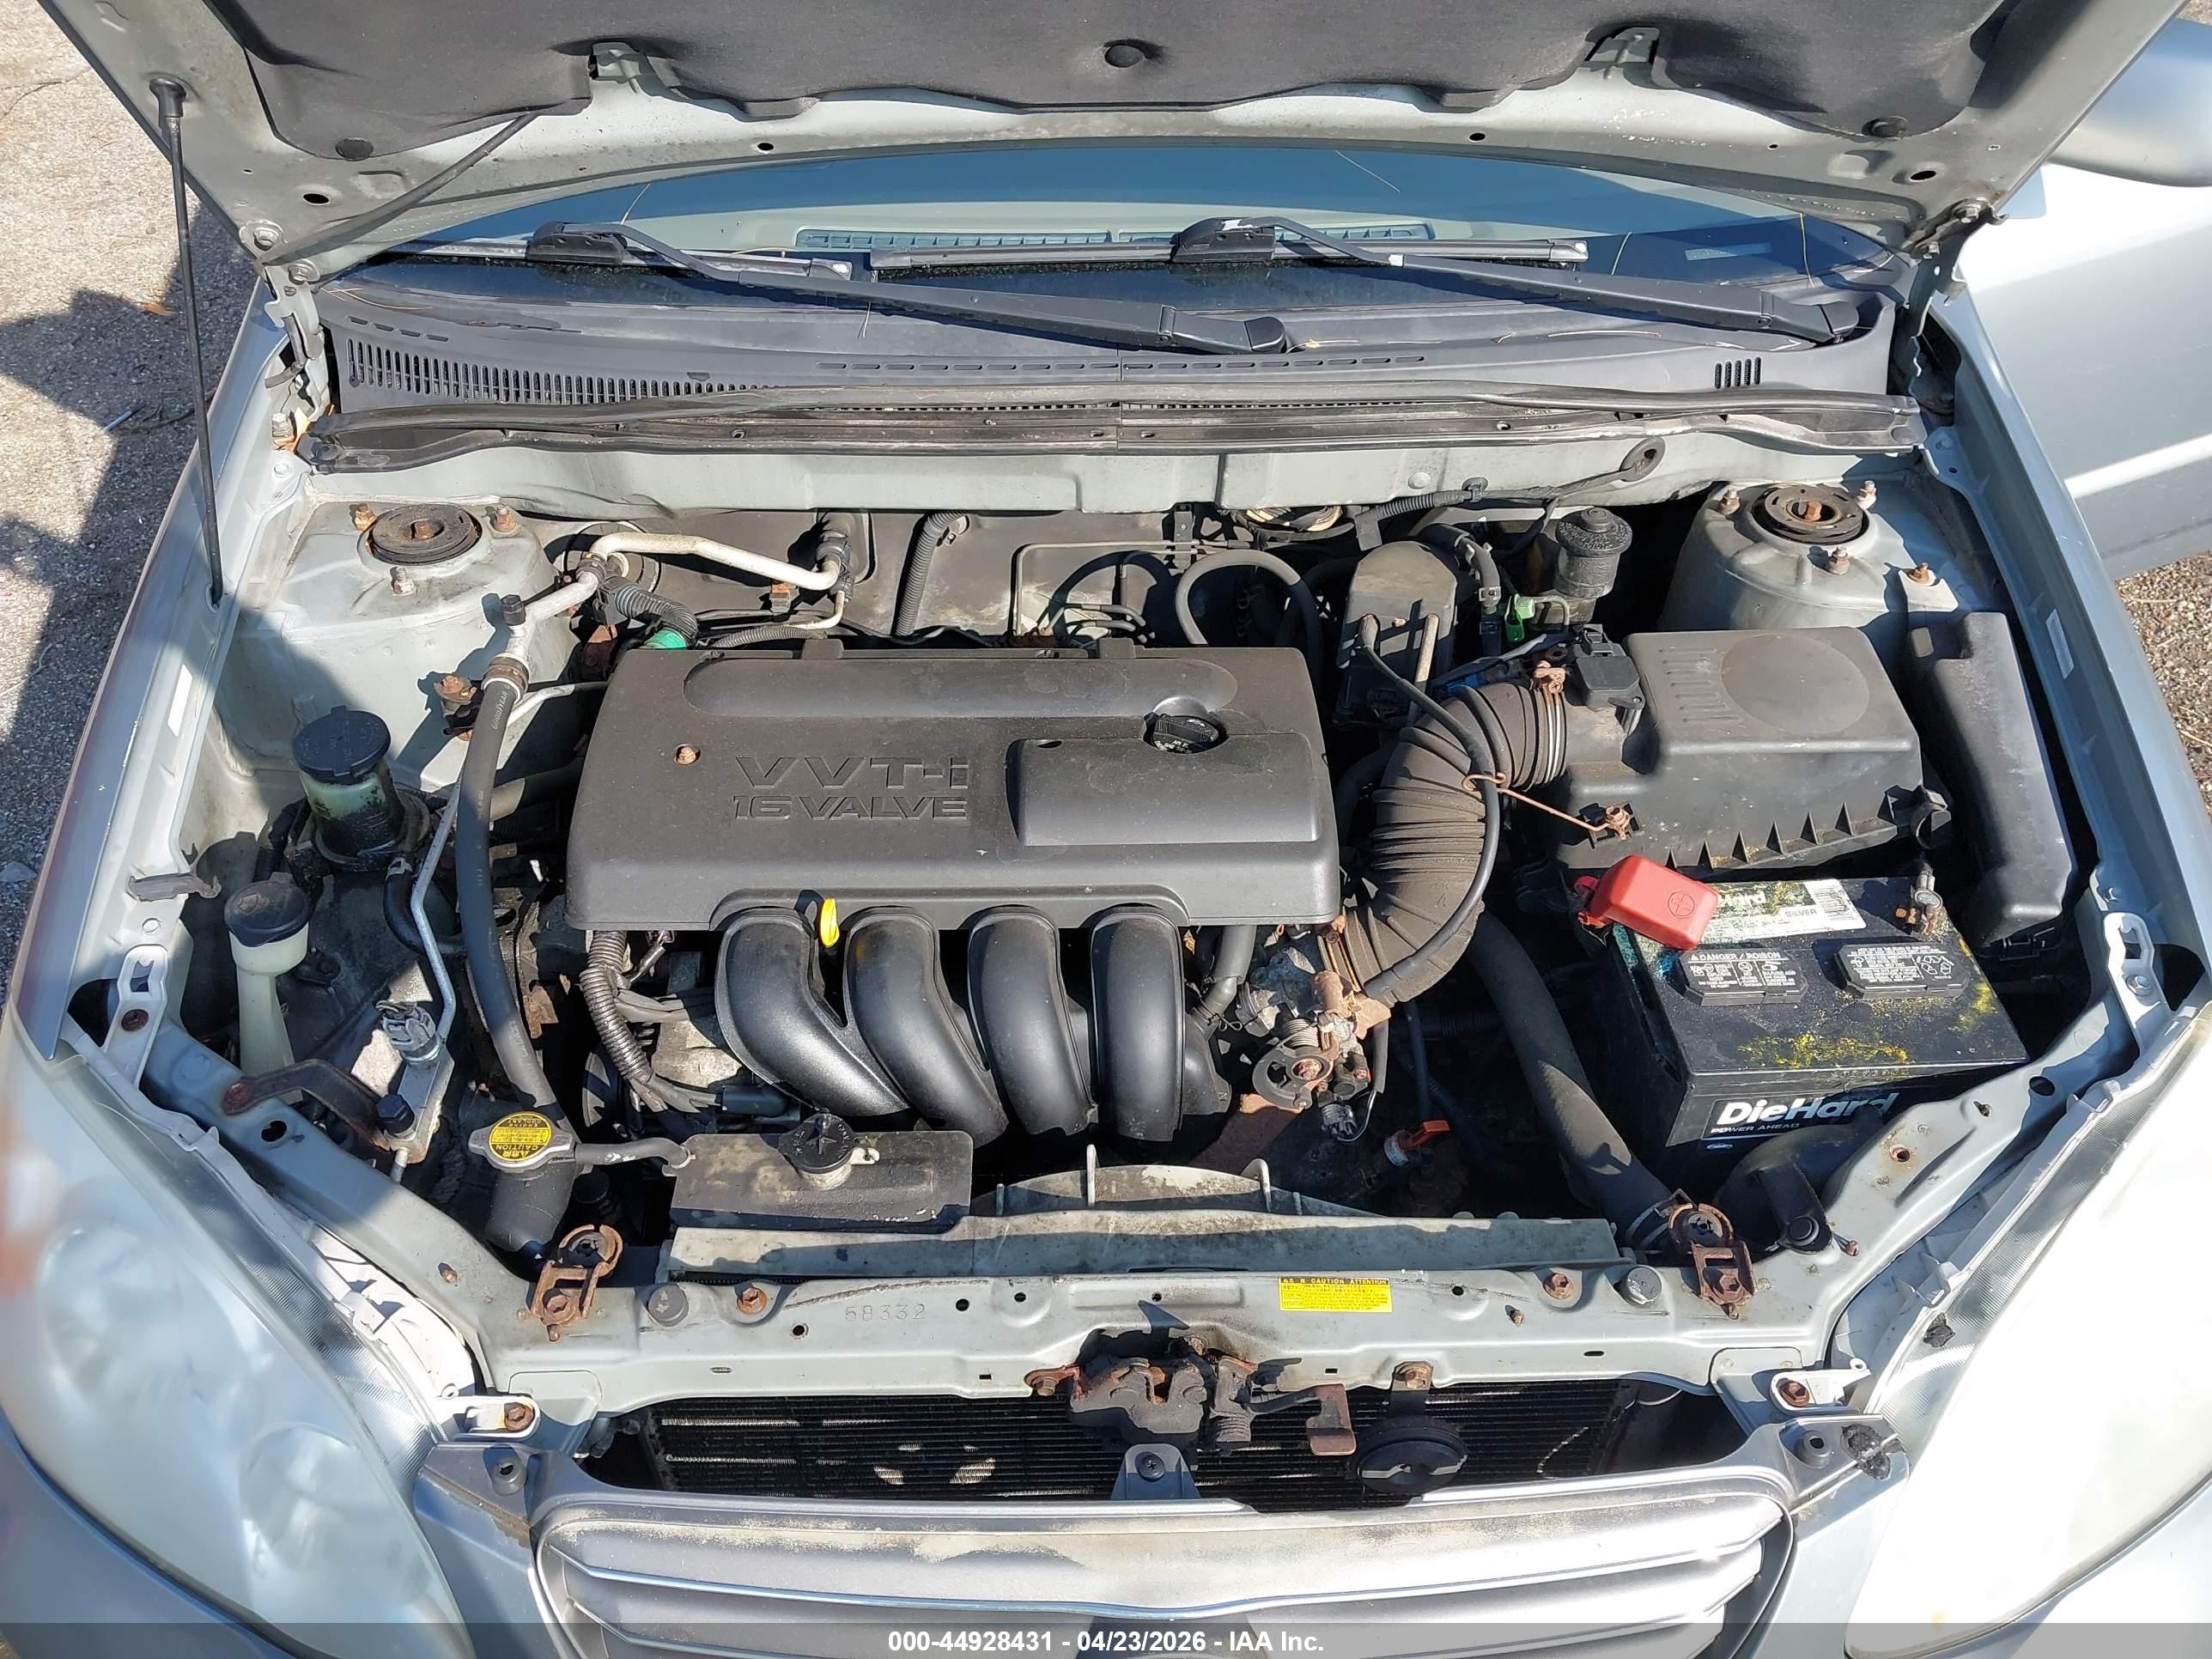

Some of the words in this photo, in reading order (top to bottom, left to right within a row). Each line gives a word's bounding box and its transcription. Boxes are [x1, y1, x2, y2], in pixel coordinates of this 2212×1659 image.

[492, 690, 508, 730] GOODYEAR
[735, 757, 969, 789] VVT-i
[733, 795, 793, 820] 16
[798, 795, 968, 820] VALVE
[1785, 908, 1817, 918] SILVER
[1717, 1092, 1900, 1126] DieHard
[1711, 1126, 1754, 1134] POWER
[1757, 1122, 1801, 1132] AHEAD
